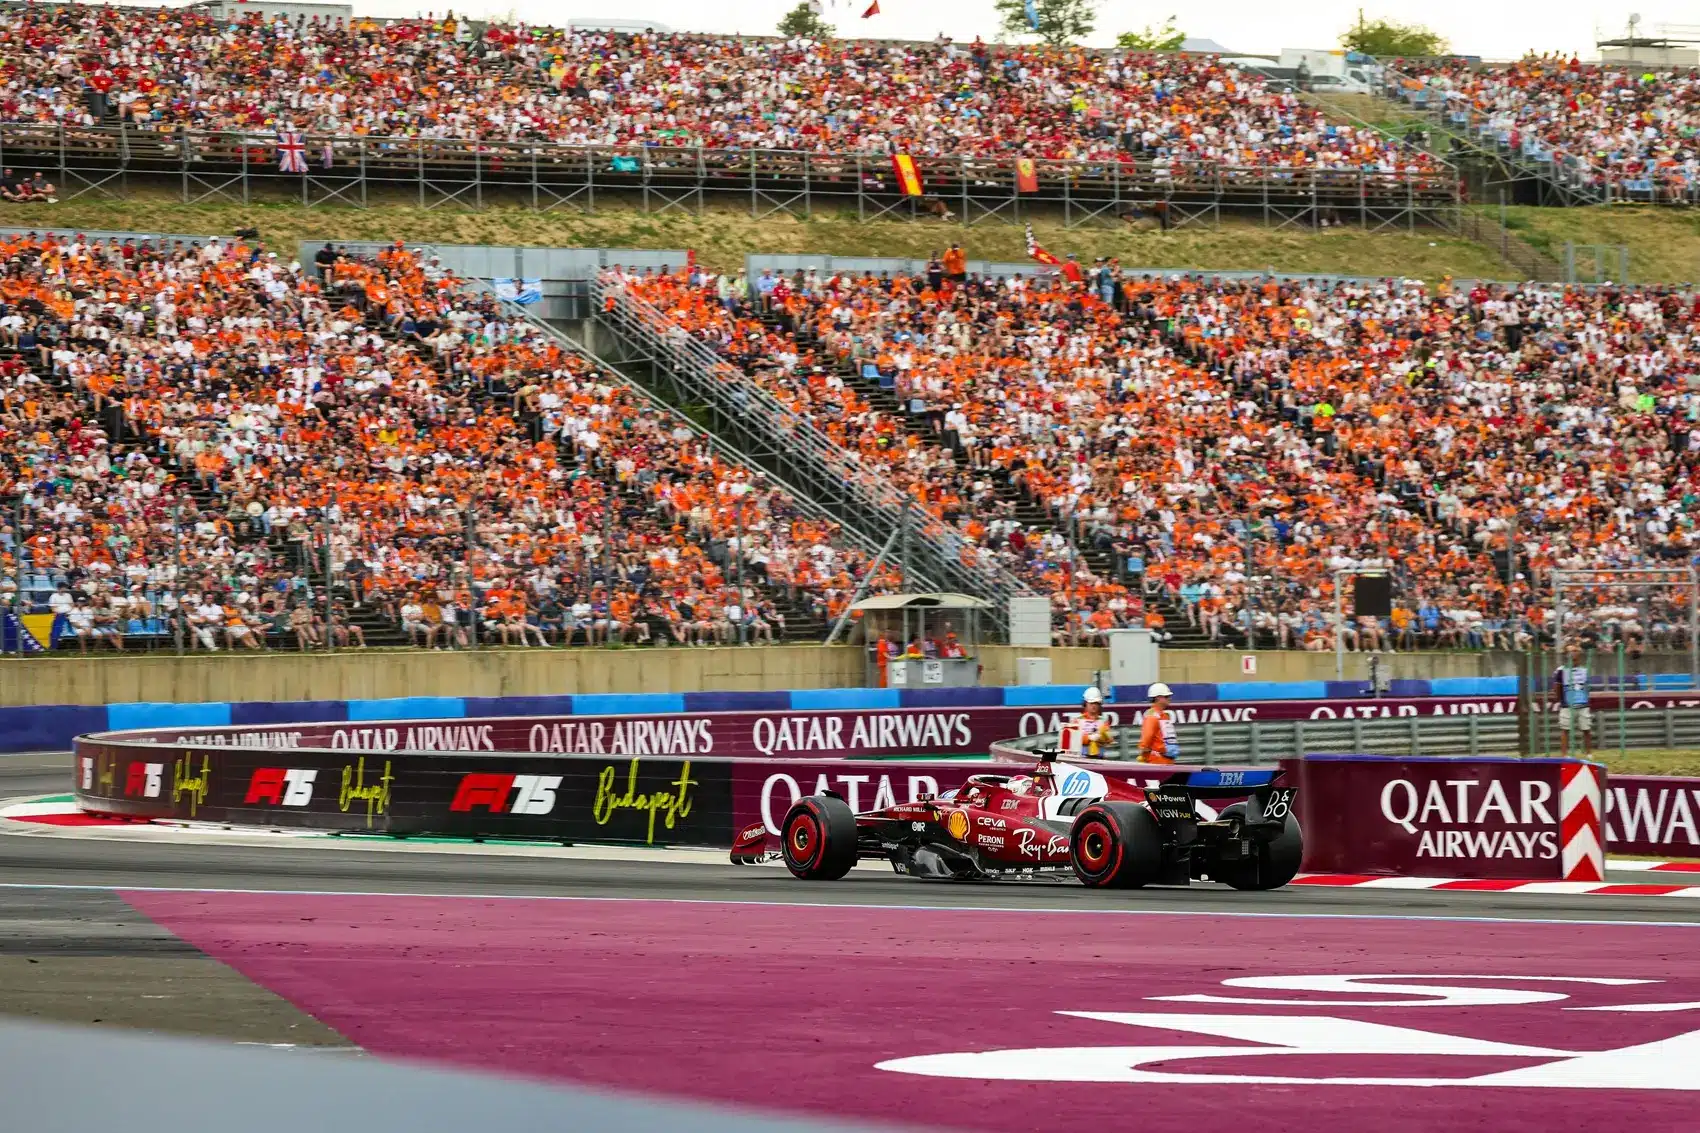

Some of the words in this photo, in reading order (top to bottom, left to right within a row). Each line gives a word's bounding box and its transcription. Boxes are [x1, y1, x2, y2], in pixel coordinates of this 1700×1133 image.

[404, 724, 495, 752] AIRWAYS
[528, 722, 606, 754] QATAR
[610, 718, 714, 755] AIRWAYS
[752, 716, 845, 755] QATAR
[849, 712, 973, 749] AIRWAYS
[1062, 771, 1091, 796] hp
[1218, 772, 1244, 786] IBM
[592, 757, 699, 844] Budapest
[1001, 799, 1020, 809] IBM
[1156, 794, 1186, 802] V-Power
[1379, 779, 1558, 835] QATAR
[1155, 808, 1179, 818] VGW
[978, 833, 1005, 845] PERONI
[1416, 831, 1559, 859] AIRWAYS
